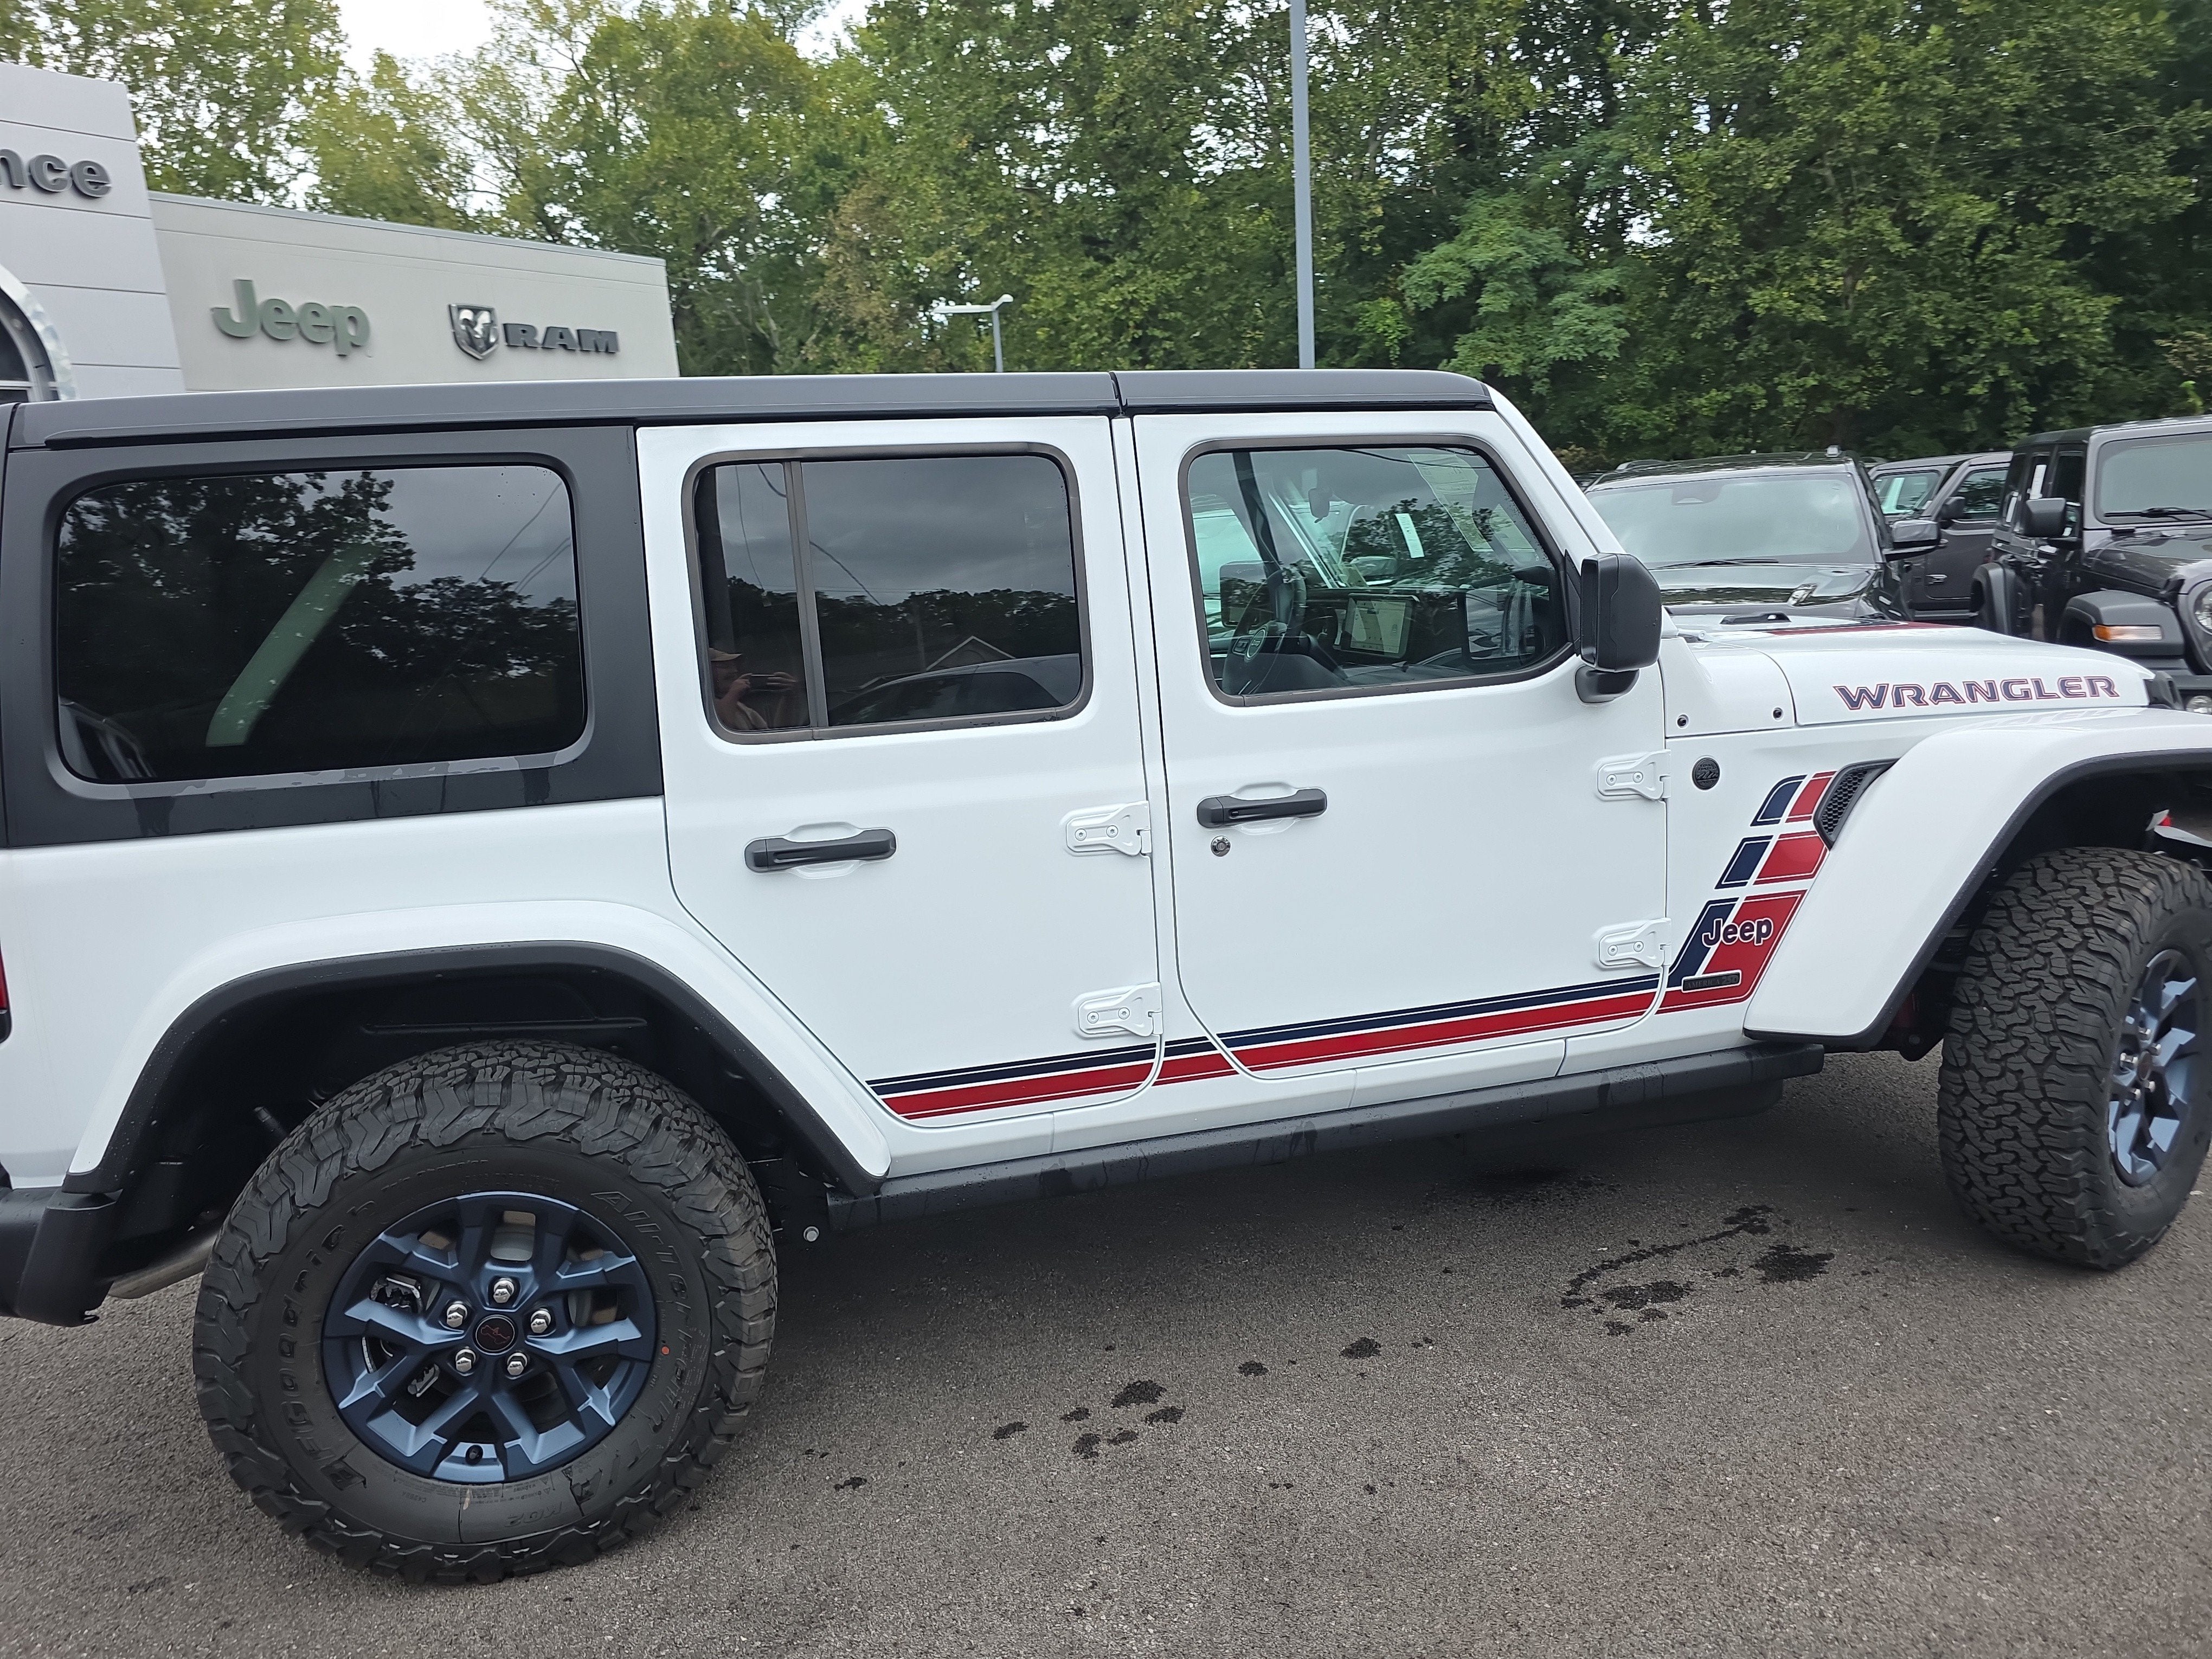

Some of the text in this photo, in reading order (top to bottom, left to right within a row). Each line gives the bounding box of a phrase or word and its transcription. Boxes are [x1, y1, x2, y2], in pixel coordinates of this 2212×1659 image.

[210, 279, 370, 356] Jeep
[503, 323, 619, 353] RAM
[1832, 676, 2120, 711] WRANGLER
[1702, 918, 1774, 946] Jeep
[1686, 979, 1720, 989] AMERICA
